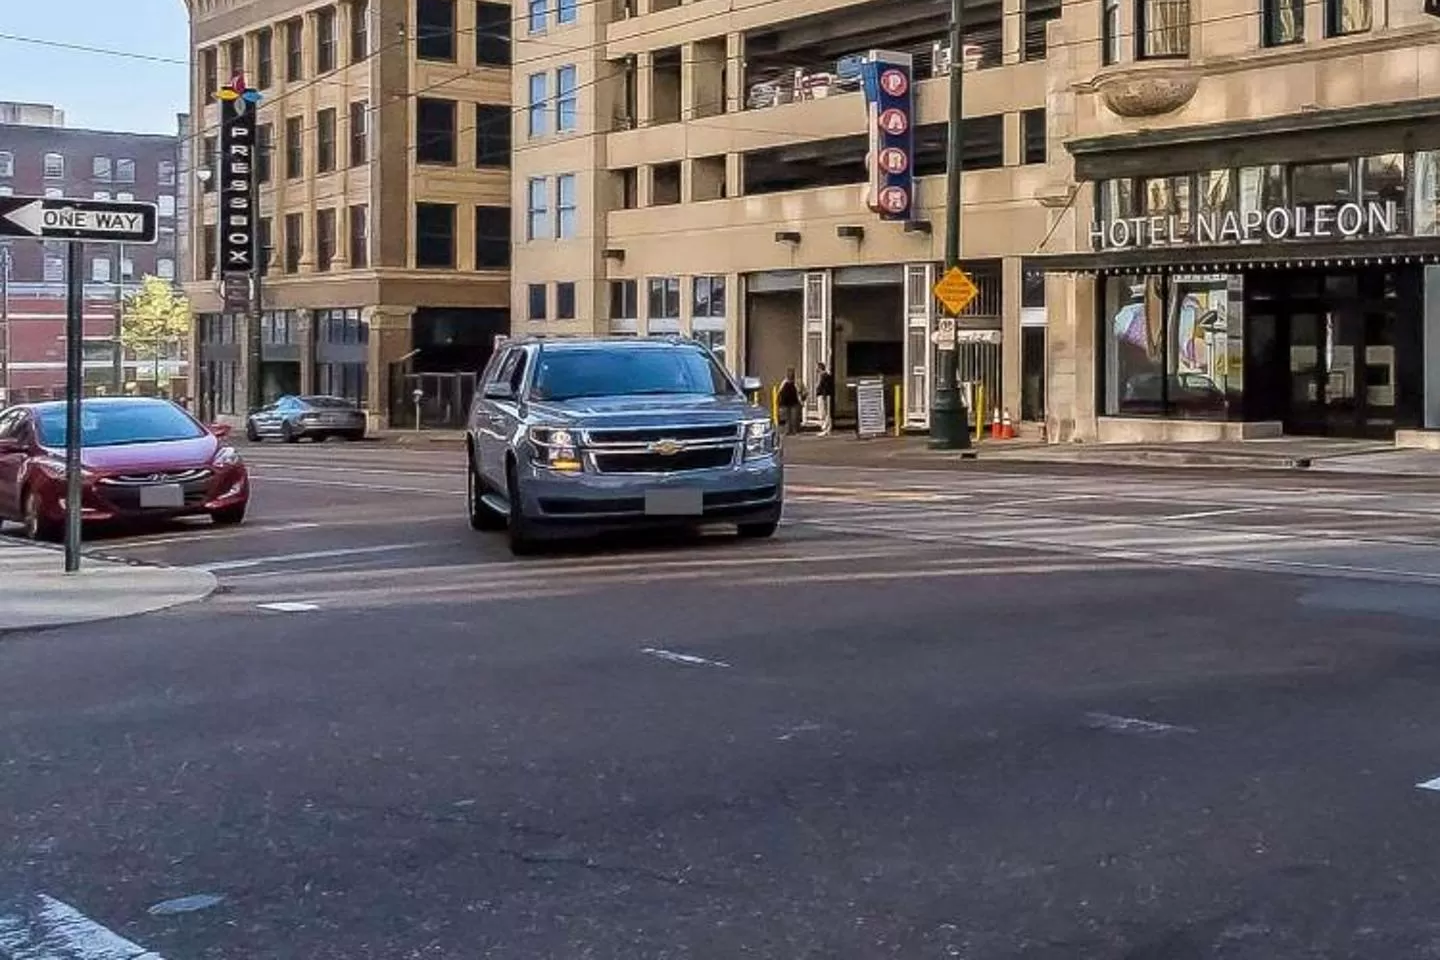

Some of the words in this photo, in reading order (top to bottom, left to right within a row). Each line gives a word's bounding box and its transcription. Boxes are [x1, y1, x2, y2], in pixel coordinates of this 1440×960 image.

[44, 210, 87, 227] ONE
[95, 213, 138, 230] WAY
[1088, 214, 1185, 248] HOTEL
[1197, 201, 1396, 241] NAPOLEON
